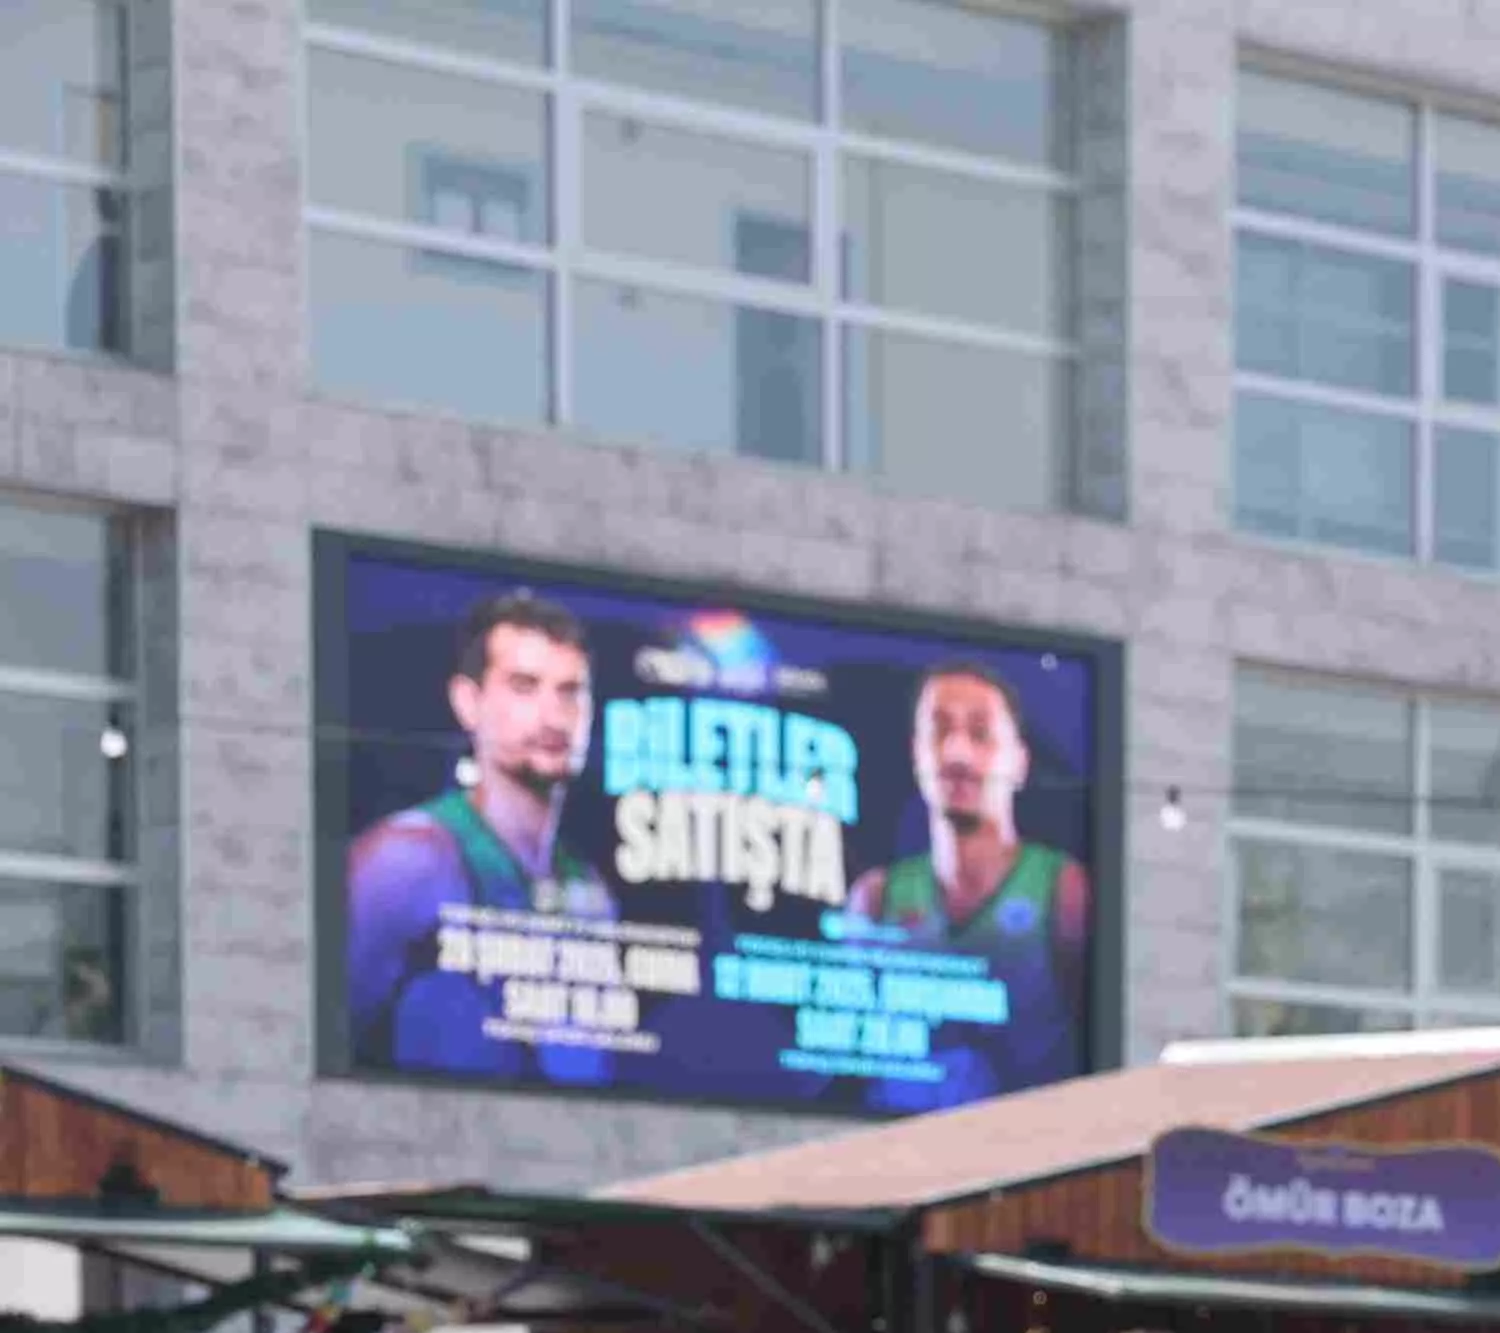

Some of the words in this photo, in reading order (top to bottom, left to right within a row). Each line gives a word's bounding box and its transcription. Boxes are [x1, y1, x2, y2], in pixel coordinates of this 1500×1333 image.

[614, 788, 847, 912] SATIŞTA
[1221, 1172, 1338, 1226] ÖMÜR
[1341, 1189, 1446, 1232] BOZA
